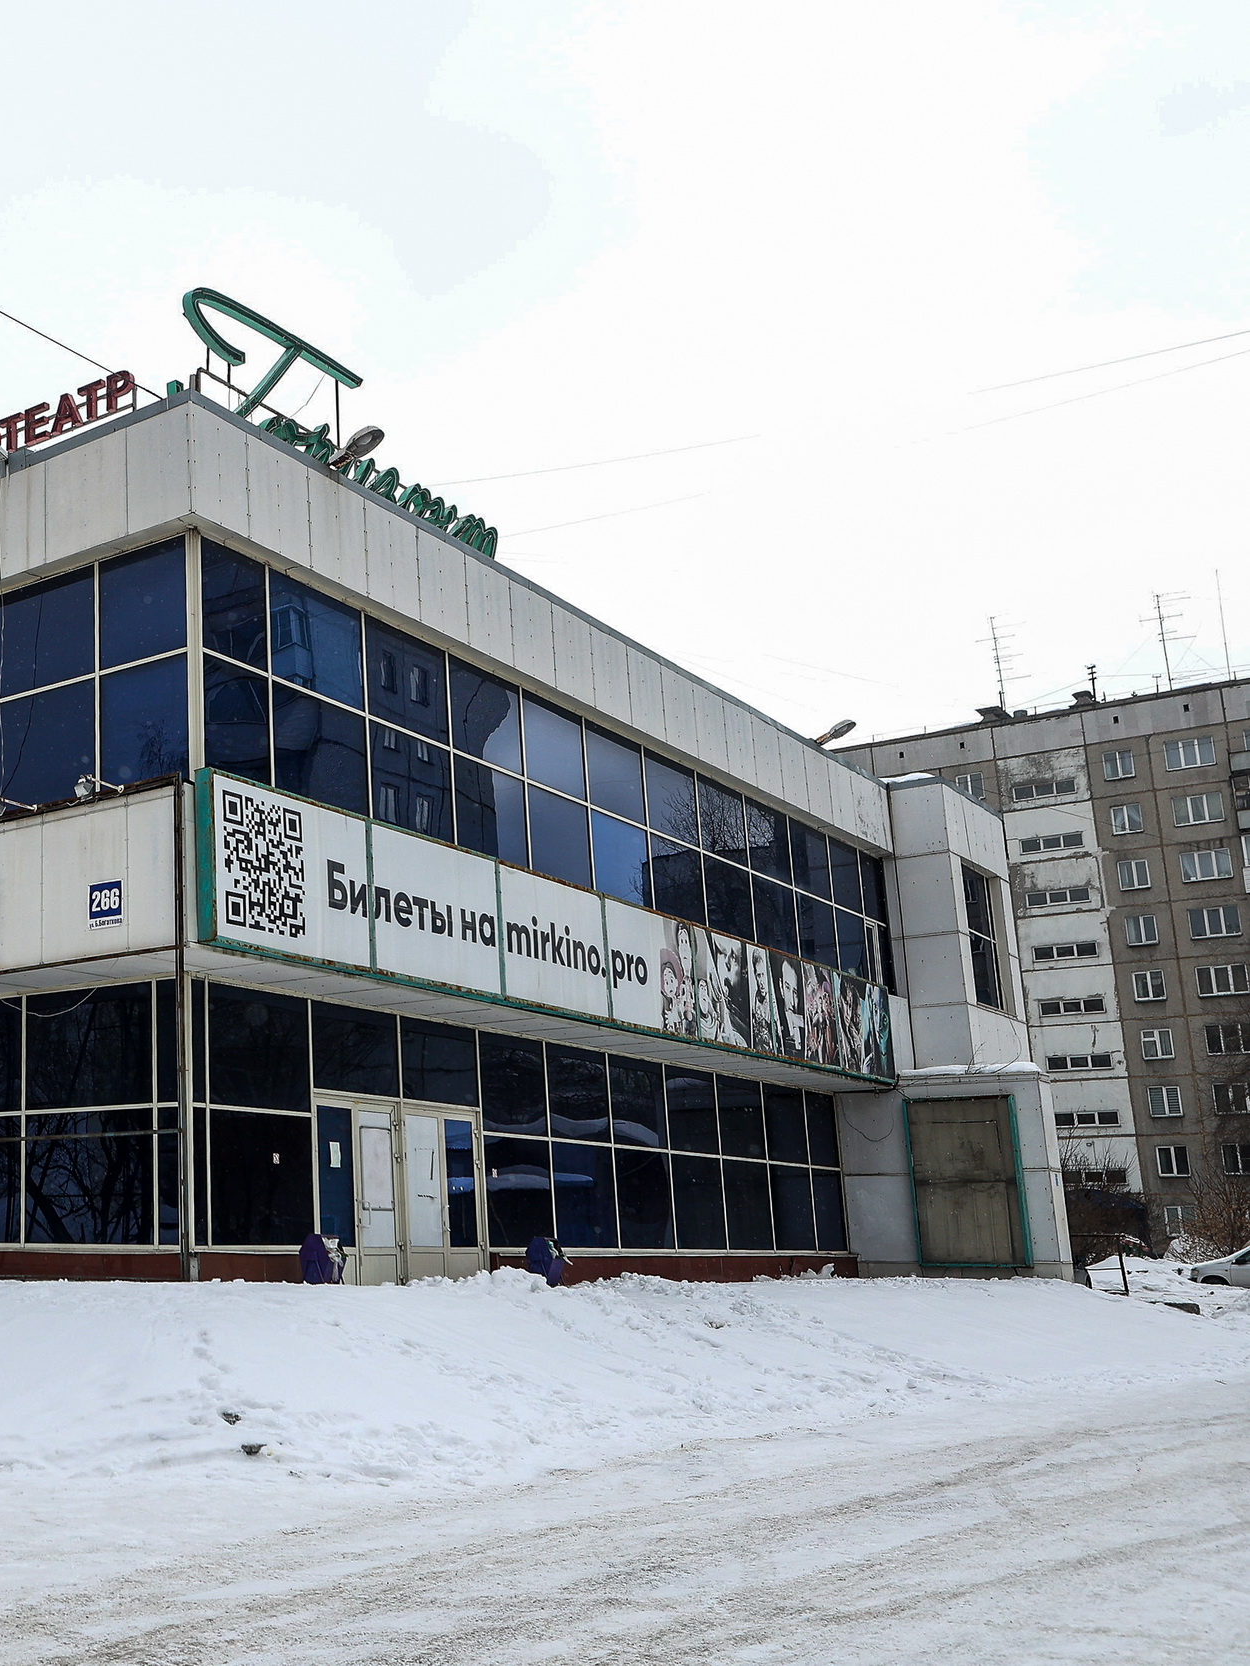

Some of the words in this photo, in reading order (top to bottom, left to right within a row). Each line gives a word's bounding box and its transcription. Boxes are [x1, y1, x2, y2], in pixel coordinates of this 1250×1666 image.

[91, 888, 120, 912] 266
[327, 859, 454, 938] Билеты
[460, 908, 497, 948] на
[506, 915, 648, 988] mirkino.pro
